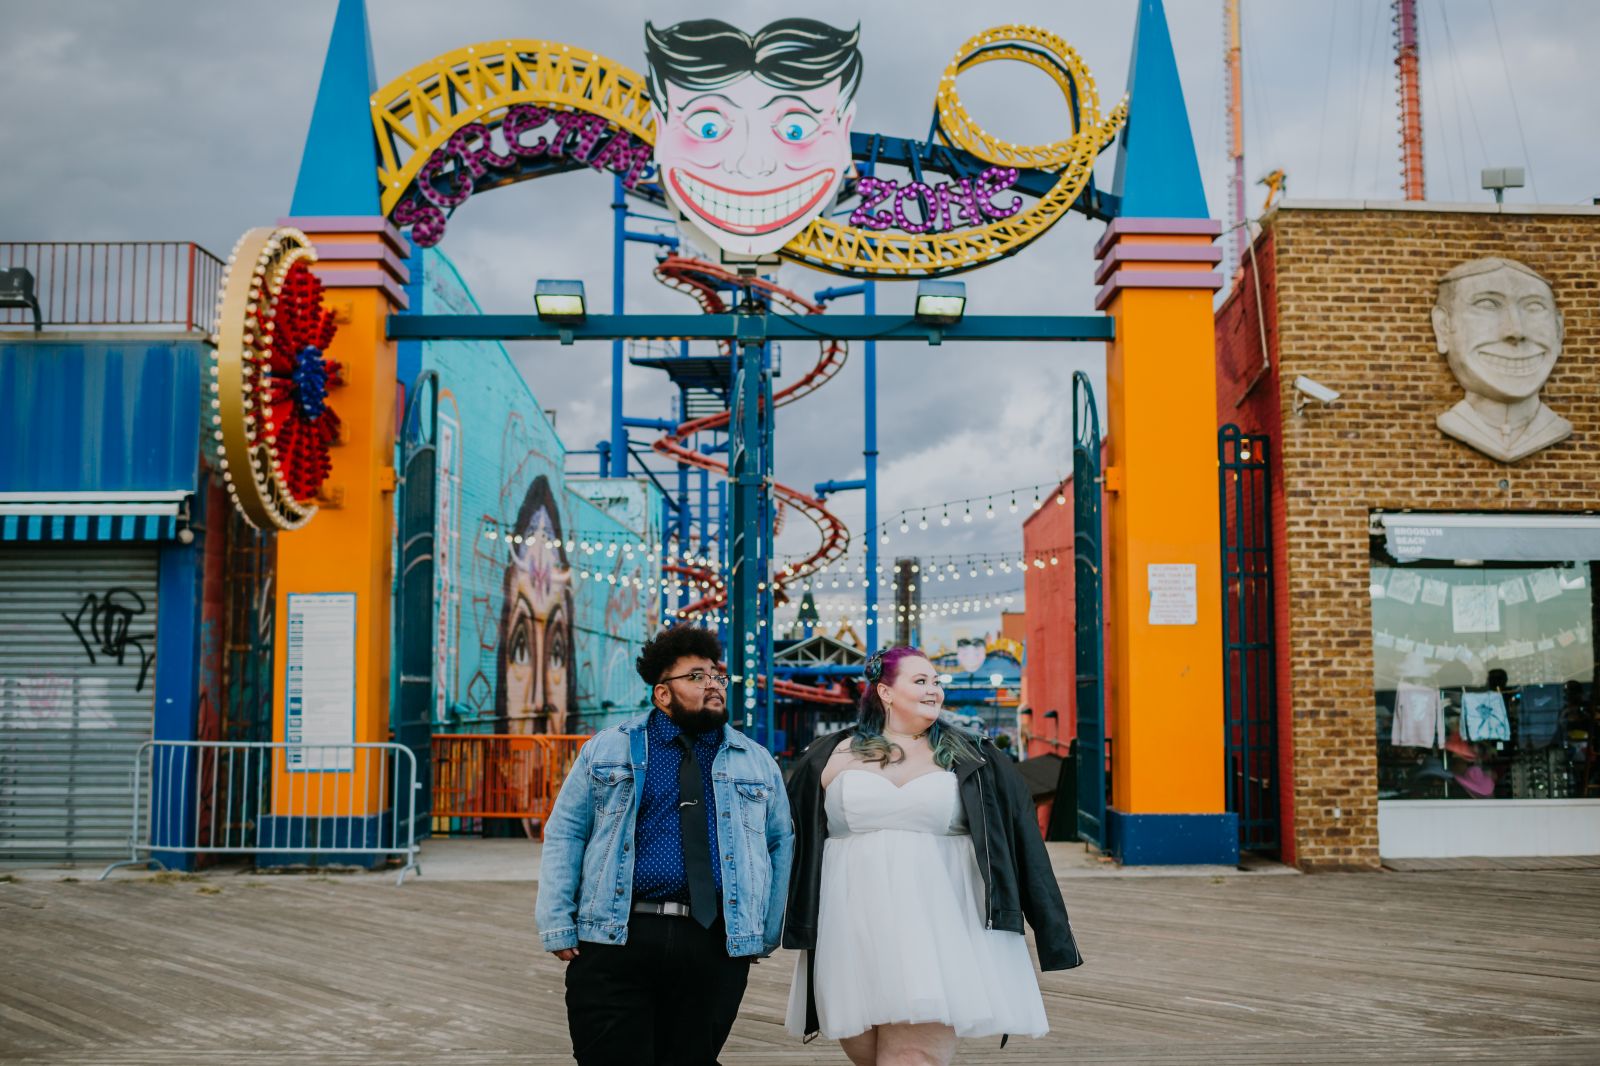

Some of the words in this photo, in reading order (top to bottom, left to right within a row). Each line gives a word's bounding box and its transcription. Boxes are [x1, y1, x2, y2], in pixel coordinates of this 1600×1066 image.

[394, 104, 652, 249] SCREAM
[849, 165, 1023, 234] ZONE
[1394, 527, 1443, 536] BROOKLYN
[1396, 536, 1426, 545] BEACH
